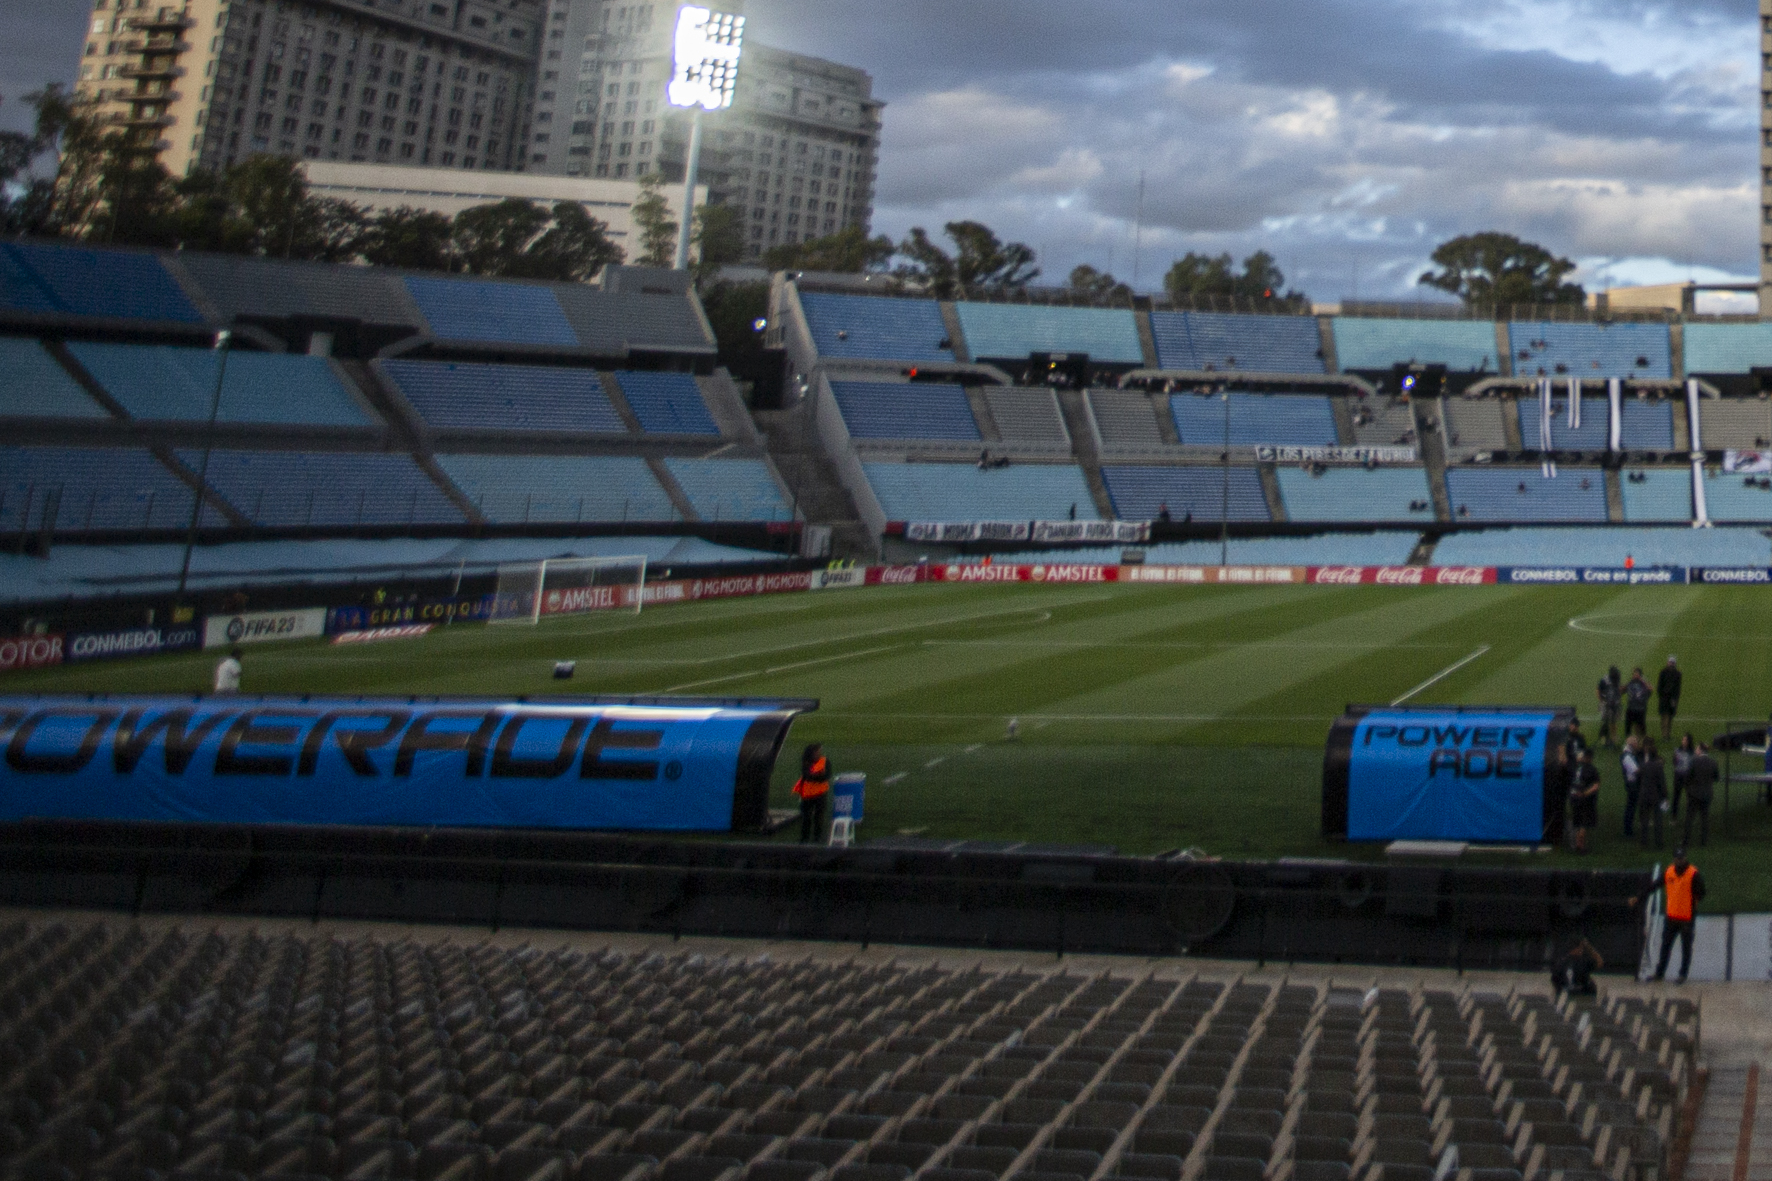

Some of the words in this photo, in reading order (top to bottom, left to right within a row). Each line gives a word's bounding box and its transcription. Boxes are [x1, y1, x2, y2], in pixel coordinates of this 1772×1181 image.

[961, 565, 1020, 581] AMSTEL
[1047, 565, 1106, 581] AMSTEL
[1511, 569, 1579, 582] CONMEBOL
[1583, 569, 1611, 582] Cree
[1612, 572, 1628, 582] en
[1629, 569, 1672, 584] grande
[1702, 570, 1771, 582] CONMEBOL
[562, 587, 615, 609] AMSTEL
[1363, 725, 1537, 748] POWER
[1429, 748, 1525, 780] ADE
